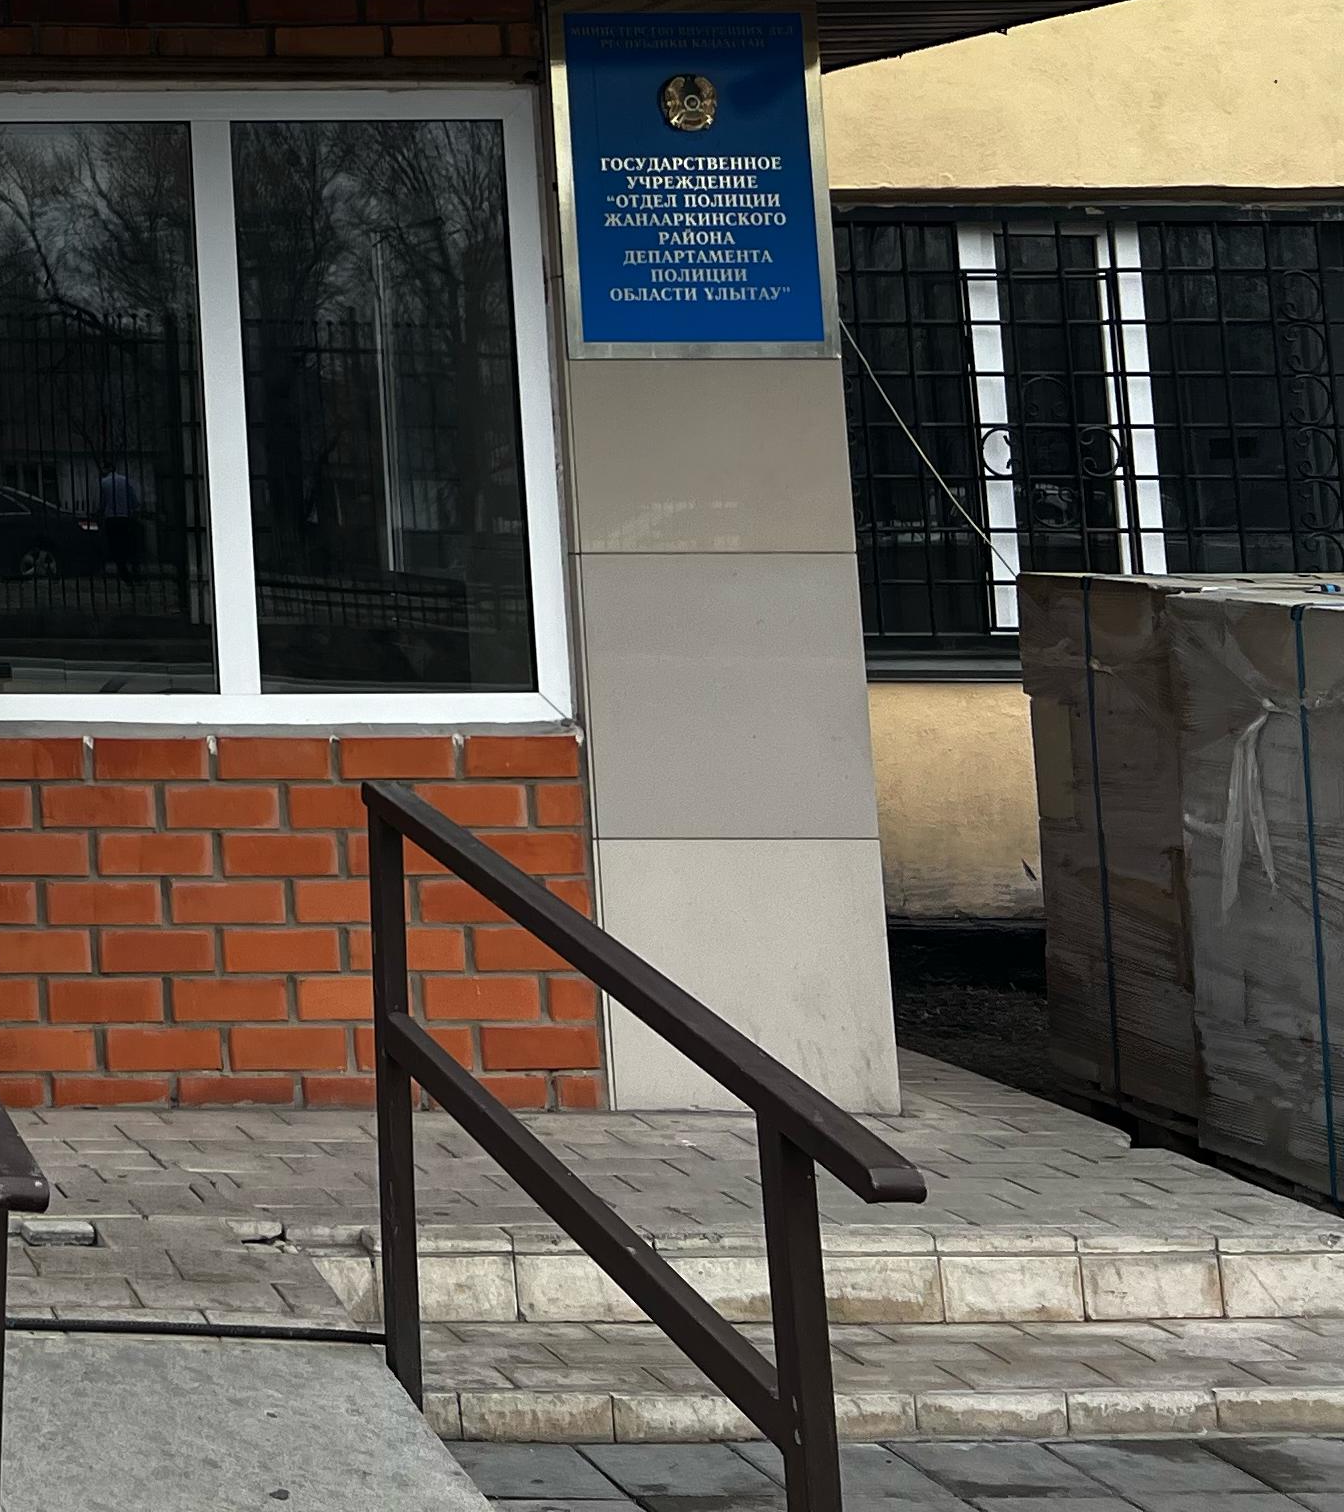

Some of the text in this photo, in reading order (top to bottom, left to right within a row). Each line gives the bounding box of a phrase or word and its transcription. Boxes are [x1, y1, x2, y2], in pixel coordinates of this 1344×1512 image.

[600, 156, 783, 173] ГОСУДАРСТВЕННОЕ
[626, 175, 759, 191] УЧРЕЖДЕНИЕ
[684, 193, 781, 209] ПОЛИЦИИ
[603, 212, 787, 227] ЖАНААРКИНСКОГО
[658, 229, 736, 245] РАЙОНА
[623, 249, 773, 266] ДЕПАРТАМЕНТА
[650, 268, 748, 284] ПОЛИЦИИ
[609, 287, 698, 302] ОБЛАСТИ
